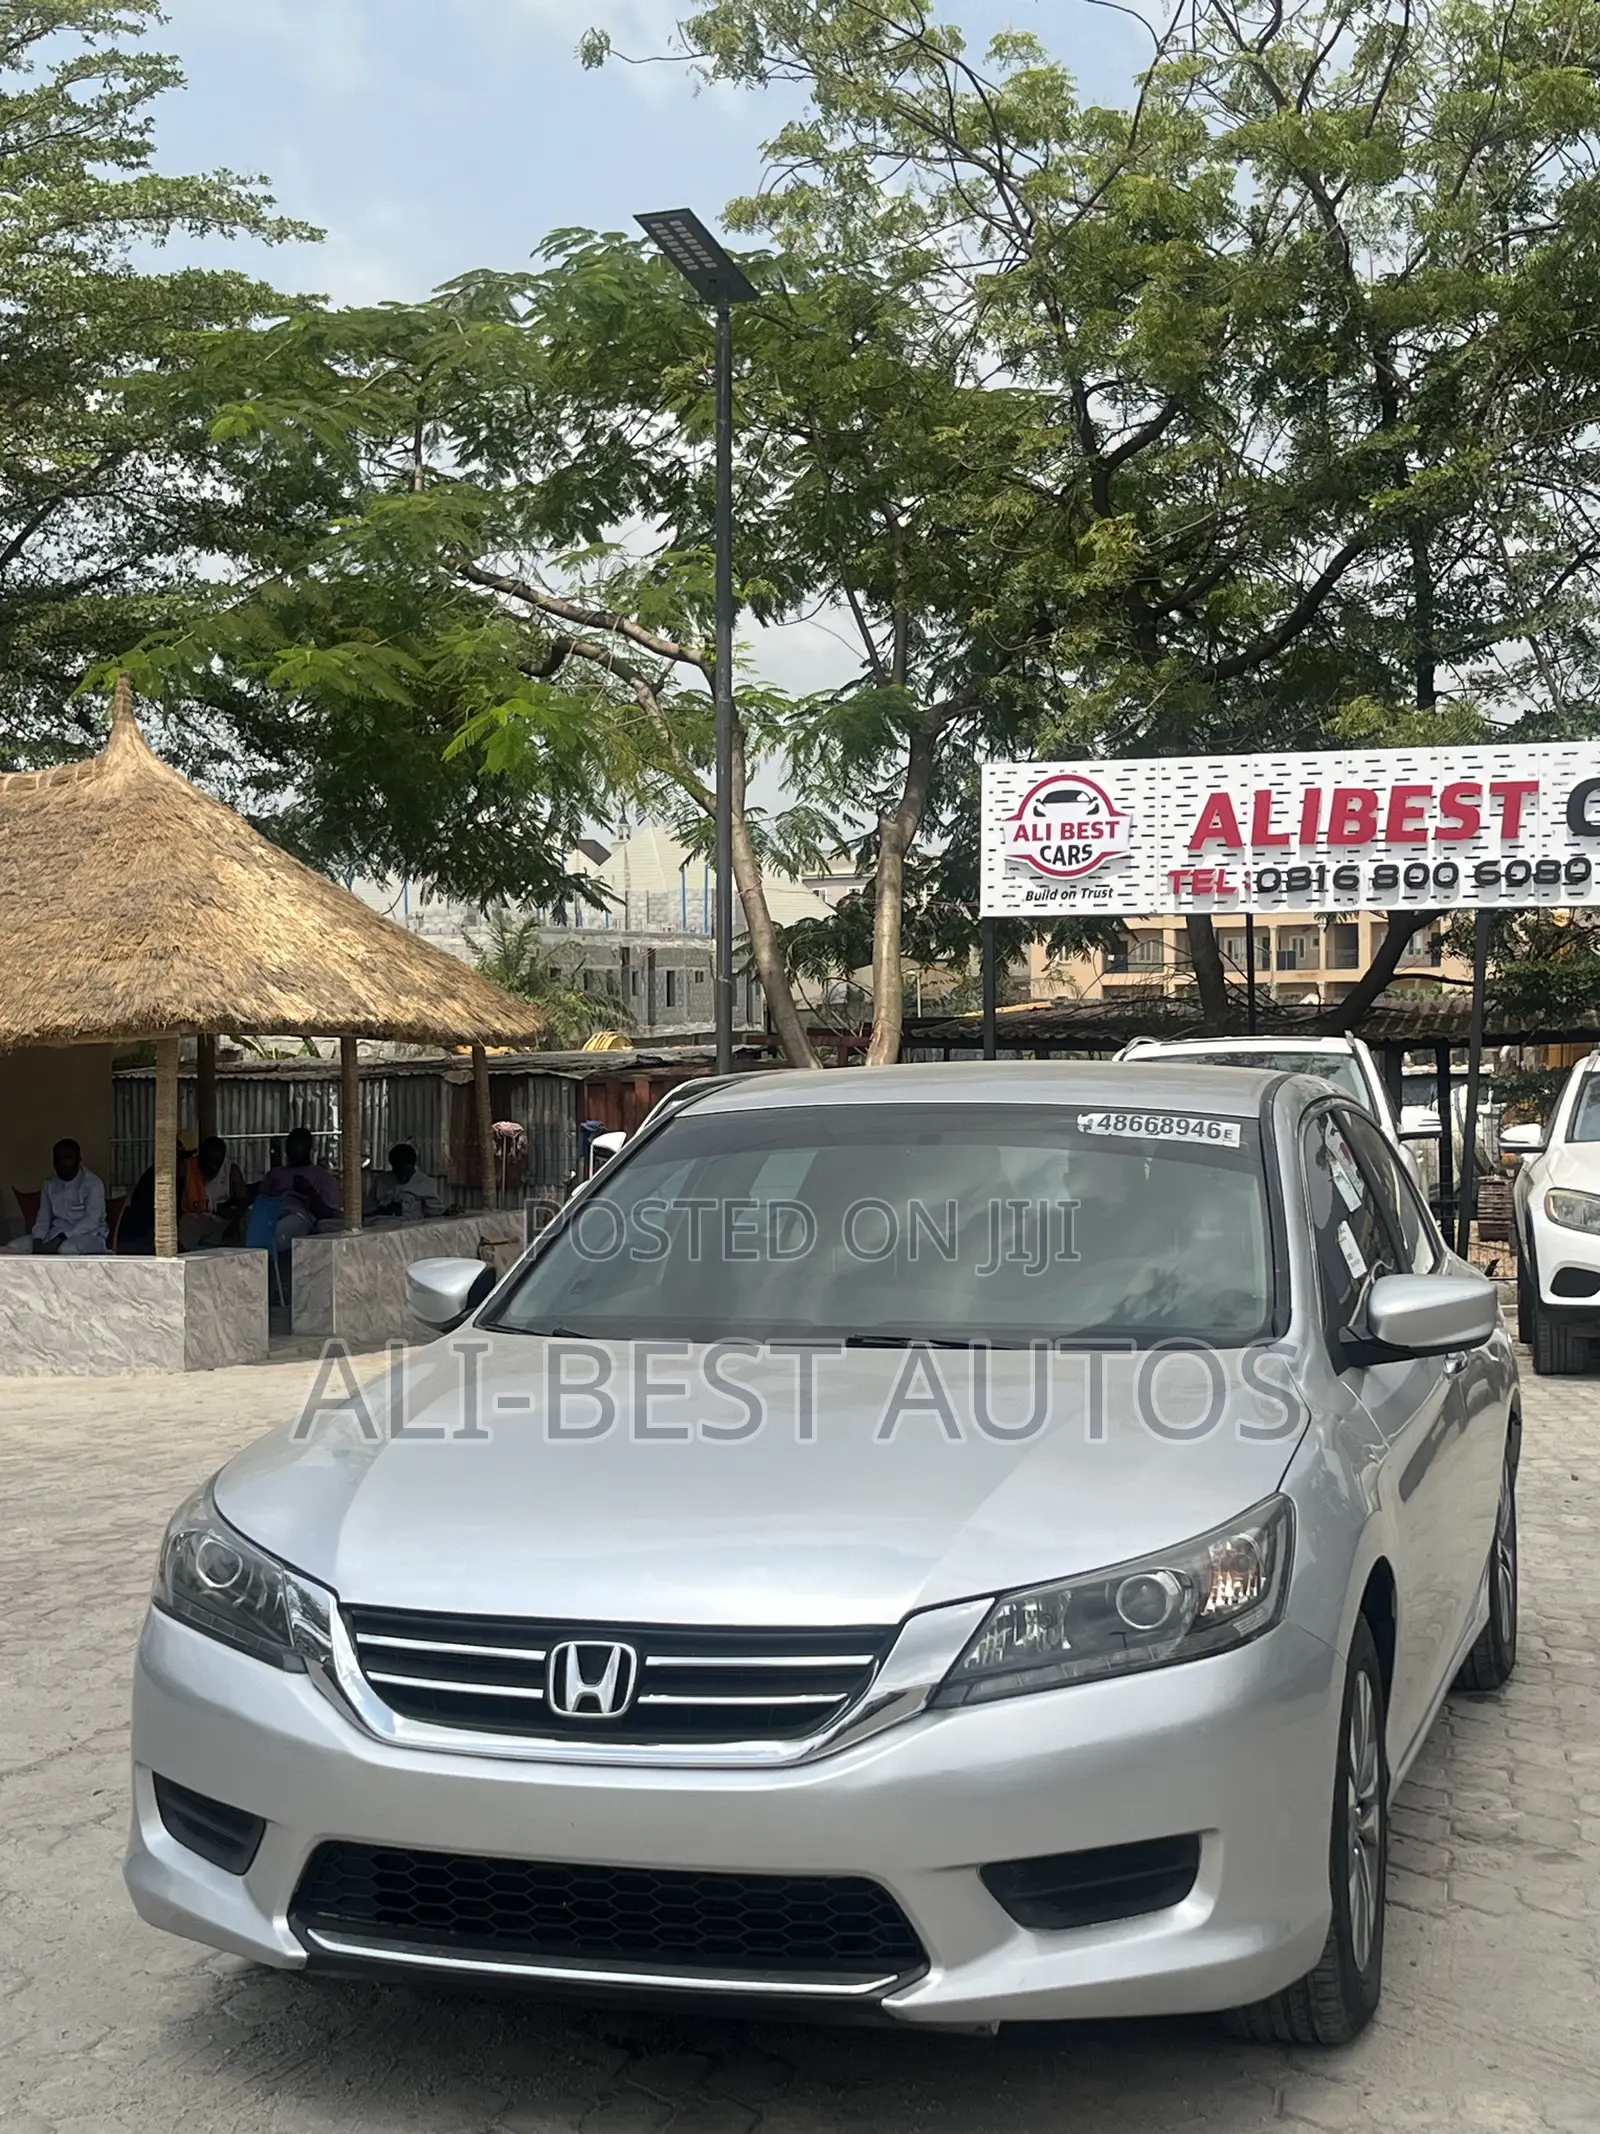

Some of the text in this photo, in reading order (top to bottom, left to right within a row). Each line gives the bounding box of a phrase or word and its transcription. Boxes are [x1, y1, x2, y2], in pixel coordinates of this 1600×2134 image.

[1188, 781, 1540, 850] ALIBEST
[1013, 820, 1120, 842] ALI BEST
[1039, 843, 1093, 867] CARS
[1256, 864, 1361, 894] 0816
[1372, 861, 1460, 889] 800
[1474, 857, 1592, 887] 6080
[1025, 887, 1114, 902] Build on Trust
